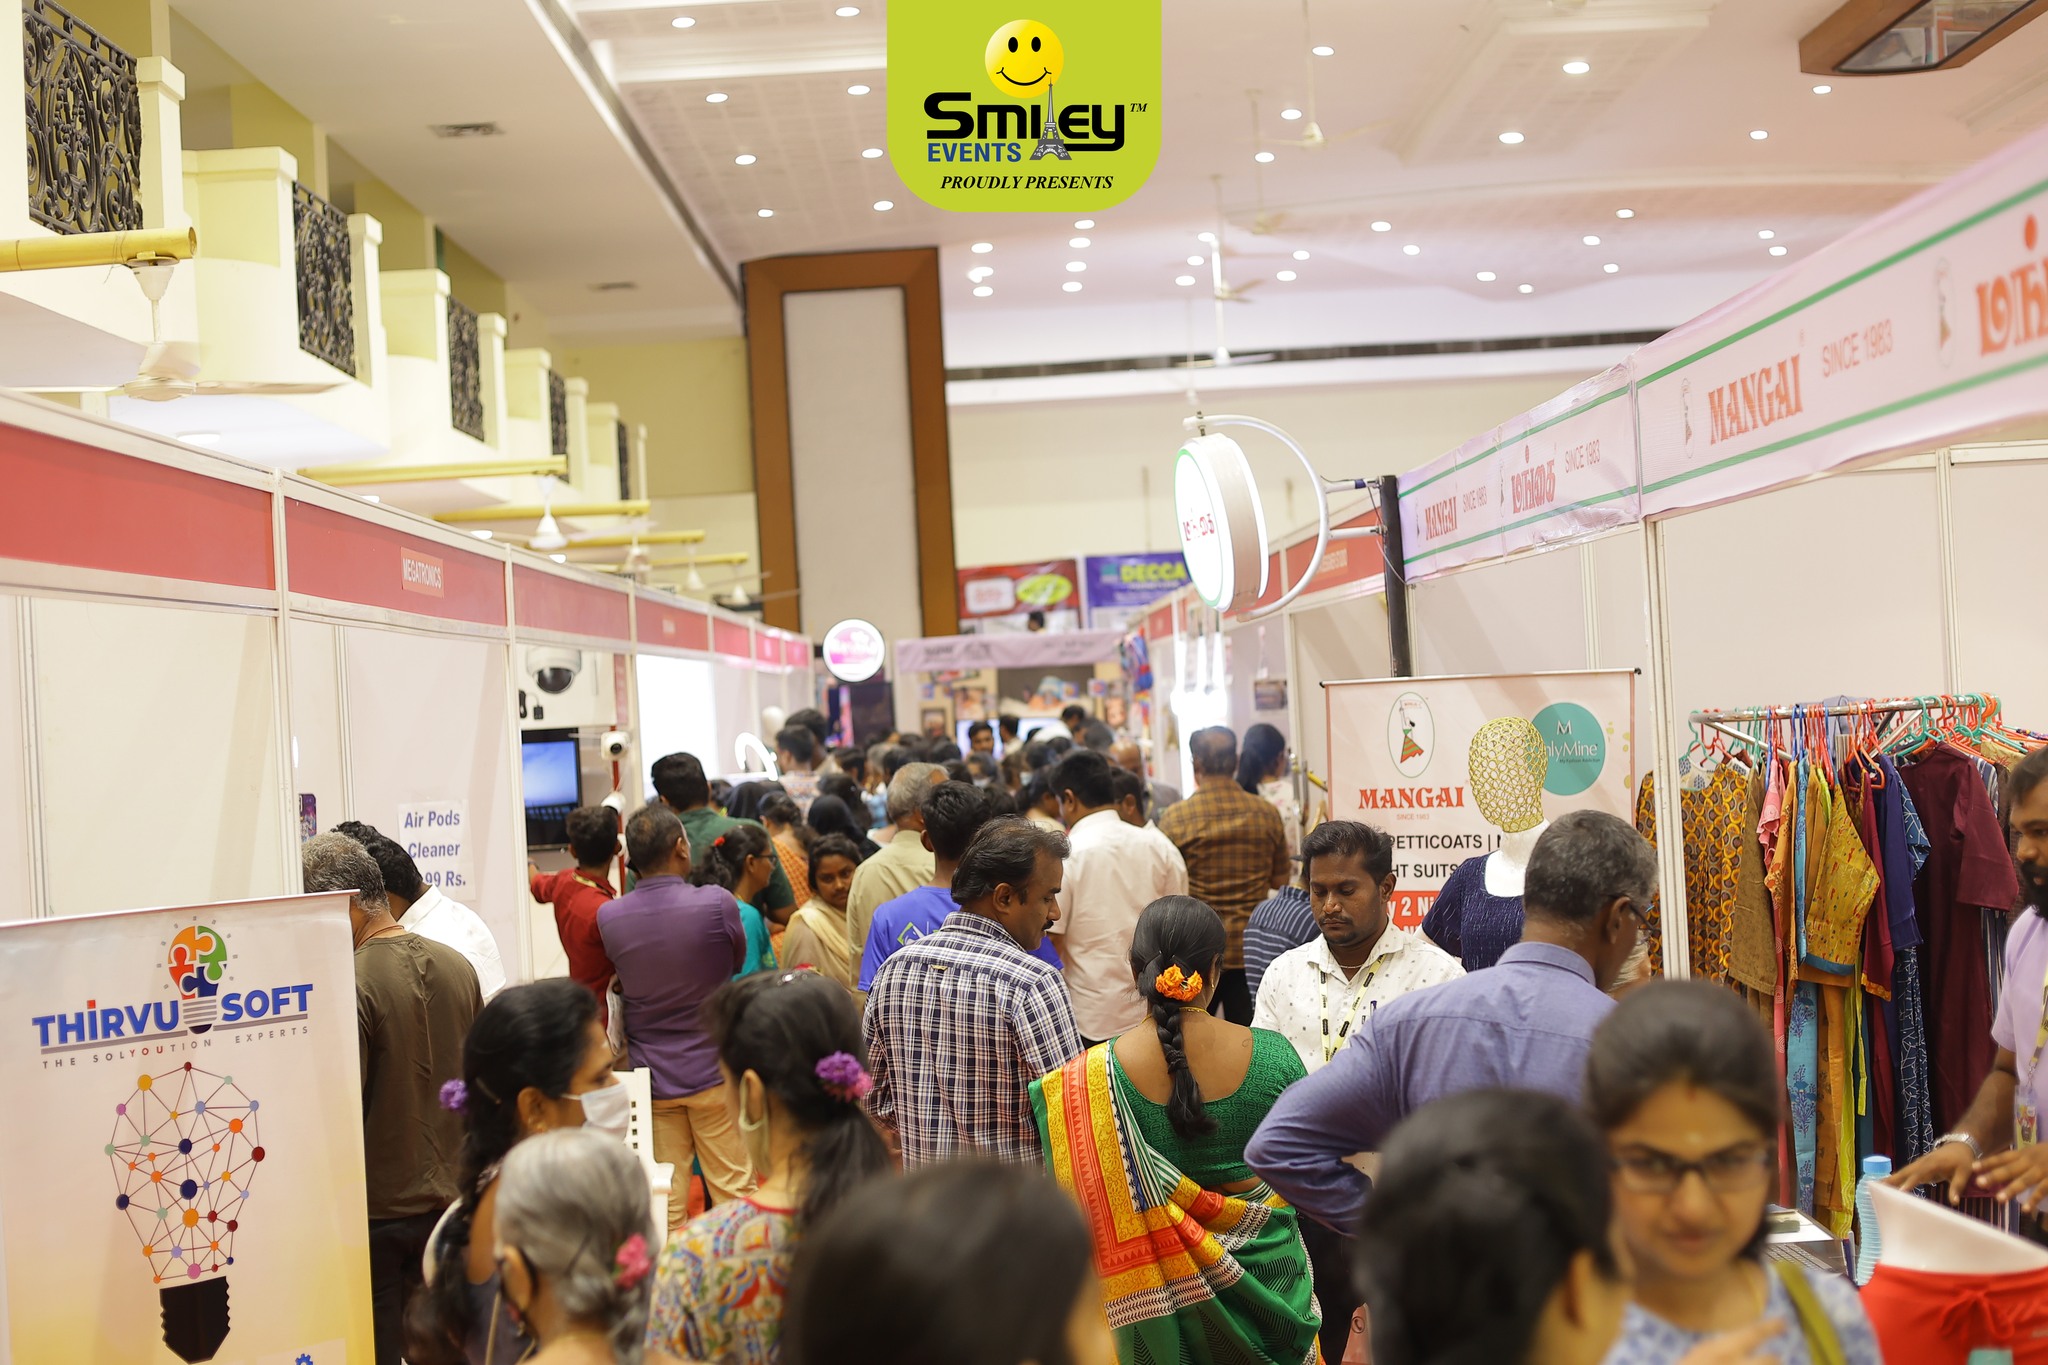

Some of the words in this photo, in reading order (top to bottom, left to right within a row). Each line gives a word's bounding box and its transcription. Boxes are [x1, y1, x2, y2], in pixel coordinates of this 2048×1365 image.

[1708, 353, 1803, 445] MANGAI
[1822, 333, 1860, 378] SINCE
[1863, 318, 1893, 362] 1983
[1565, 445, 1584, 473] SINCE
[1586, 439, 1601, 468] 1983
[1424, 496, 1457, 541] MANGAI
[402, 557, 442, 590] MEGATRONICS
[1546, 740, 1598, 762] nlyMine
[1358, 786, 1464, 809] MANGAI
[404, 811, 424, 829] Air
[428, 809, 460, 827] Pods
[408, 842, 460, 858] Cleaner
[445, 870, 466, 887] Rs.
[1401, 897, 1411, 917] 2
[221, 983, 313, 1022] SOFT
[42, 1057, 77, 1069] THE
[93, 1038, 212, 1064] SOLYOUTION
[235, 1025, 309, 1044] EXPERTS
